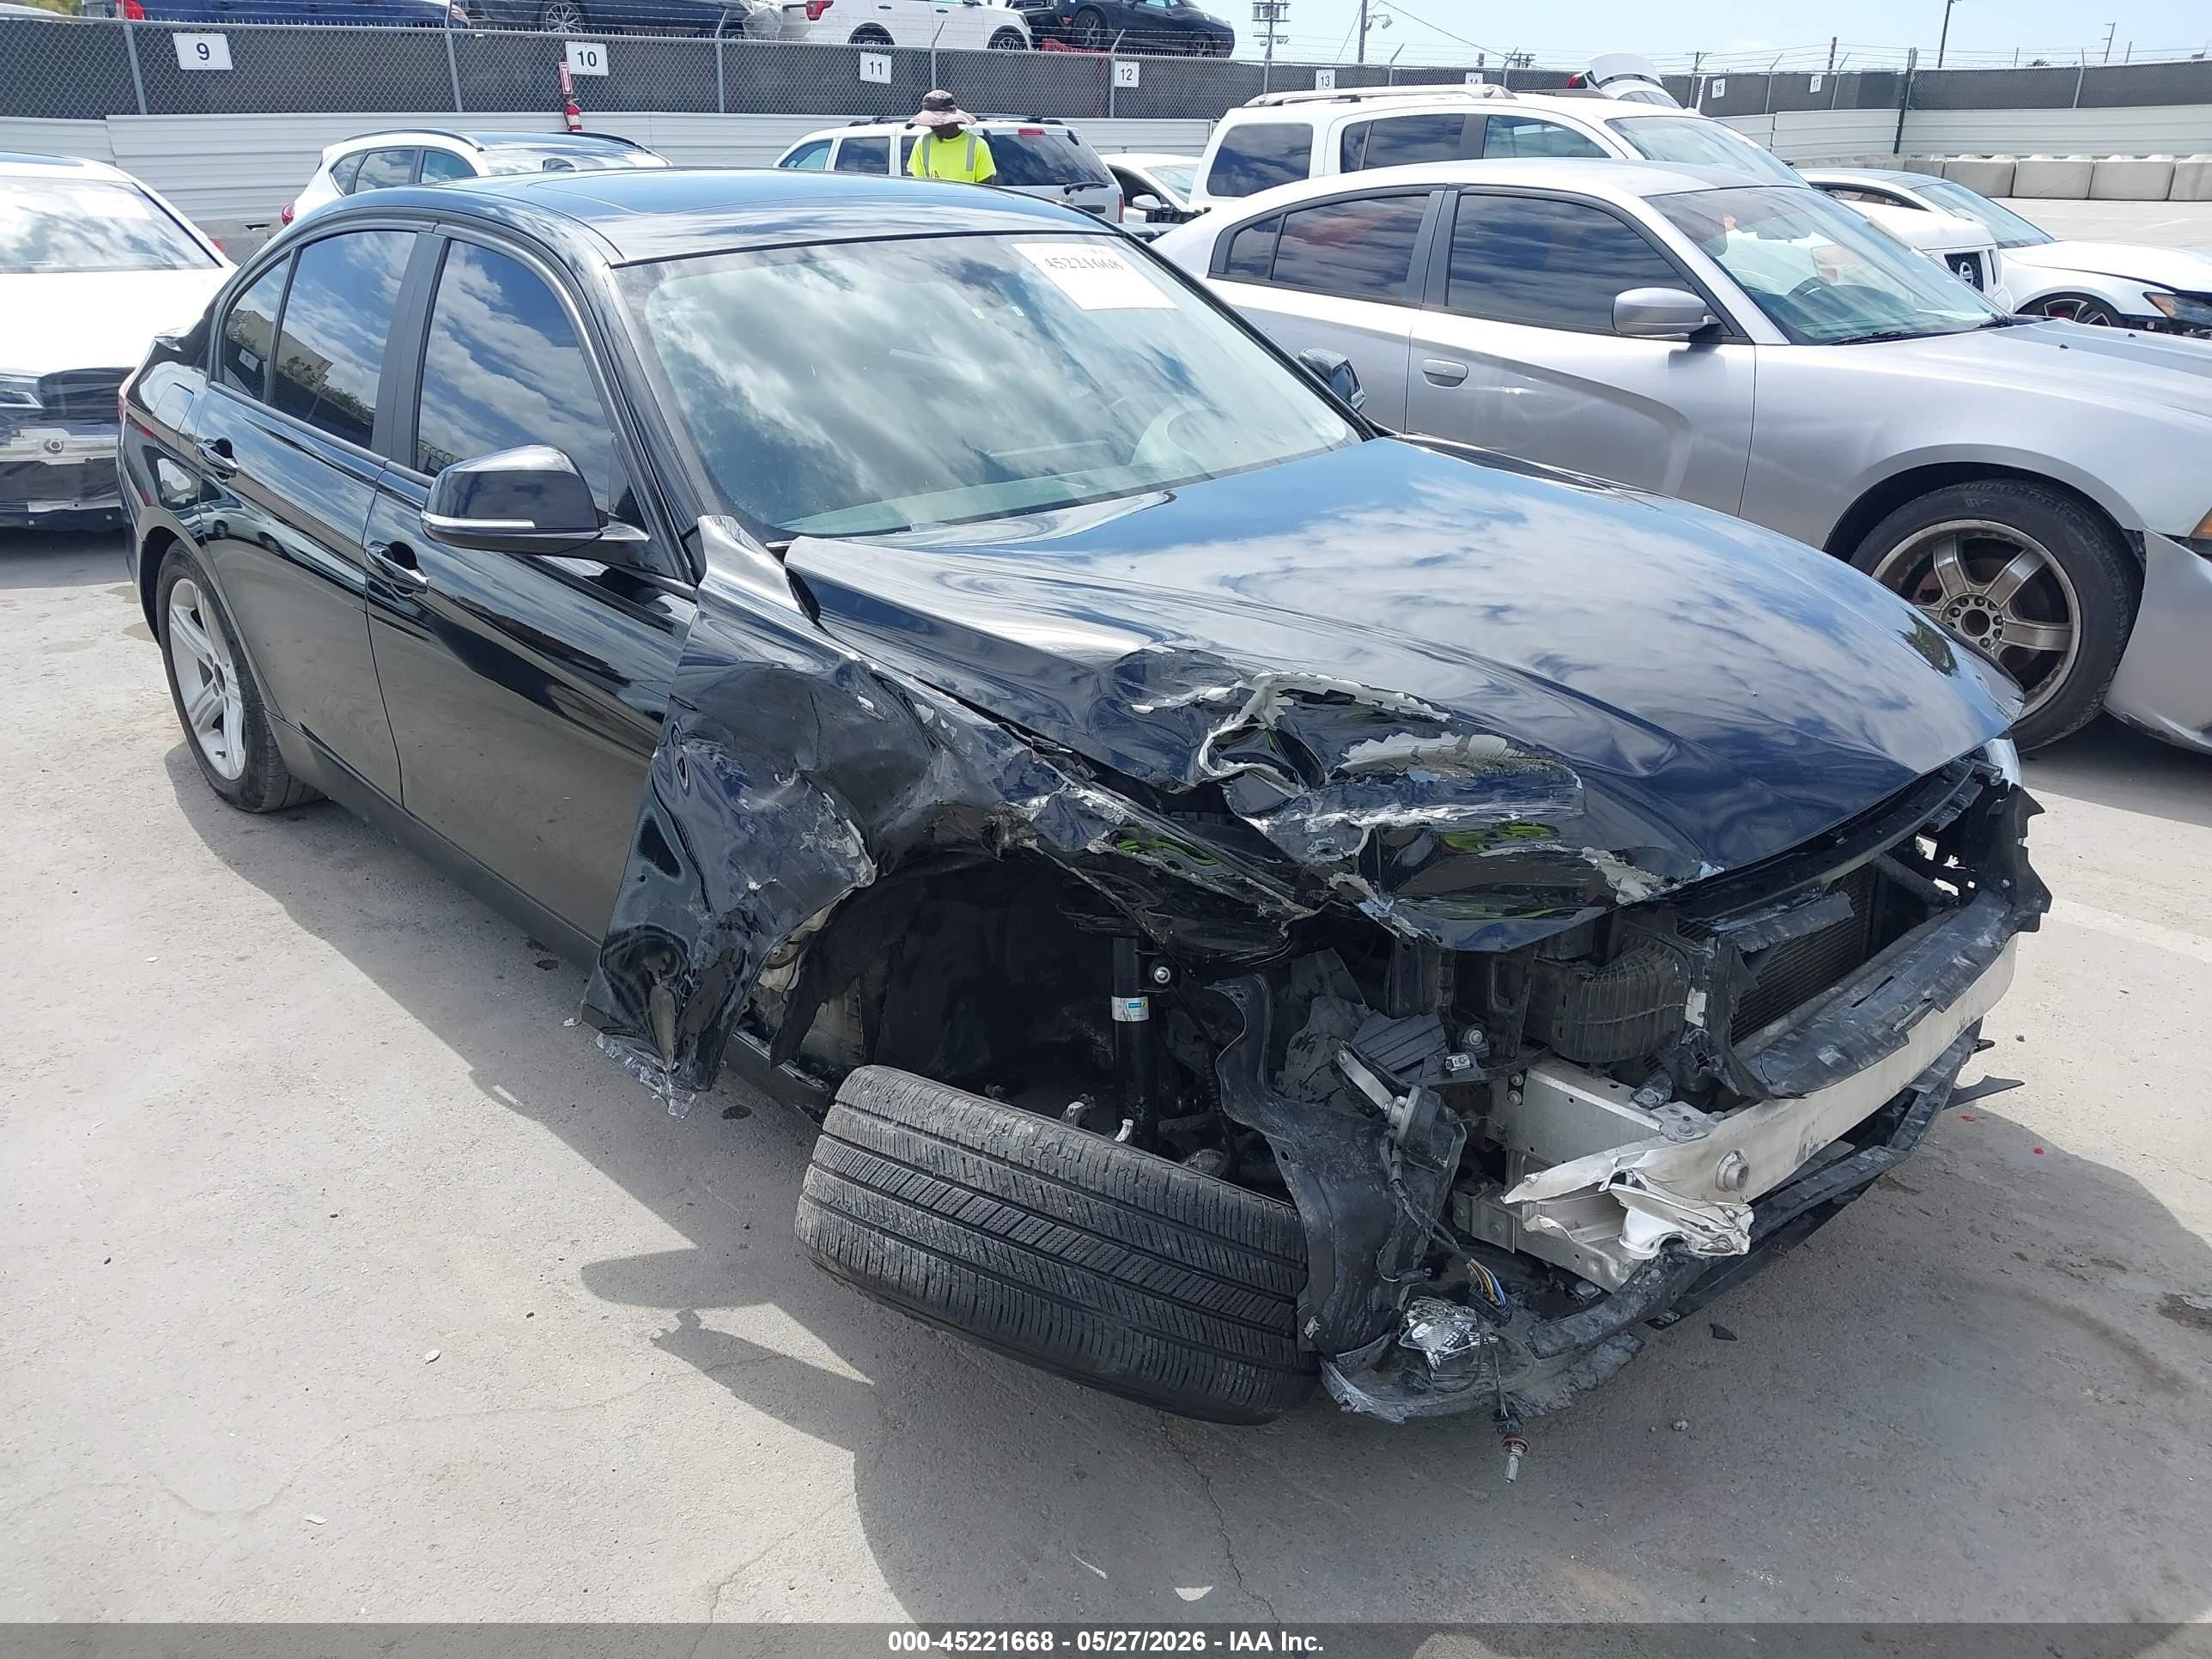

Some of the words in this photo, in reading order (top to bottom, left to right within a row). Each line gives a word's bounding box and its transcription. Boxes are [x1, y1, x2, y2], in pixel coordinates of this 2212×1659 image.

[196, 42, 210, 61] 9
[576, 50, 598, 67] 10
[868, 60, 883, 76] 11
[1120, 68, 1133, 81] 12
[1320, 75, 1330, 88] 13
[1813, 79, 1820, 88] 17
